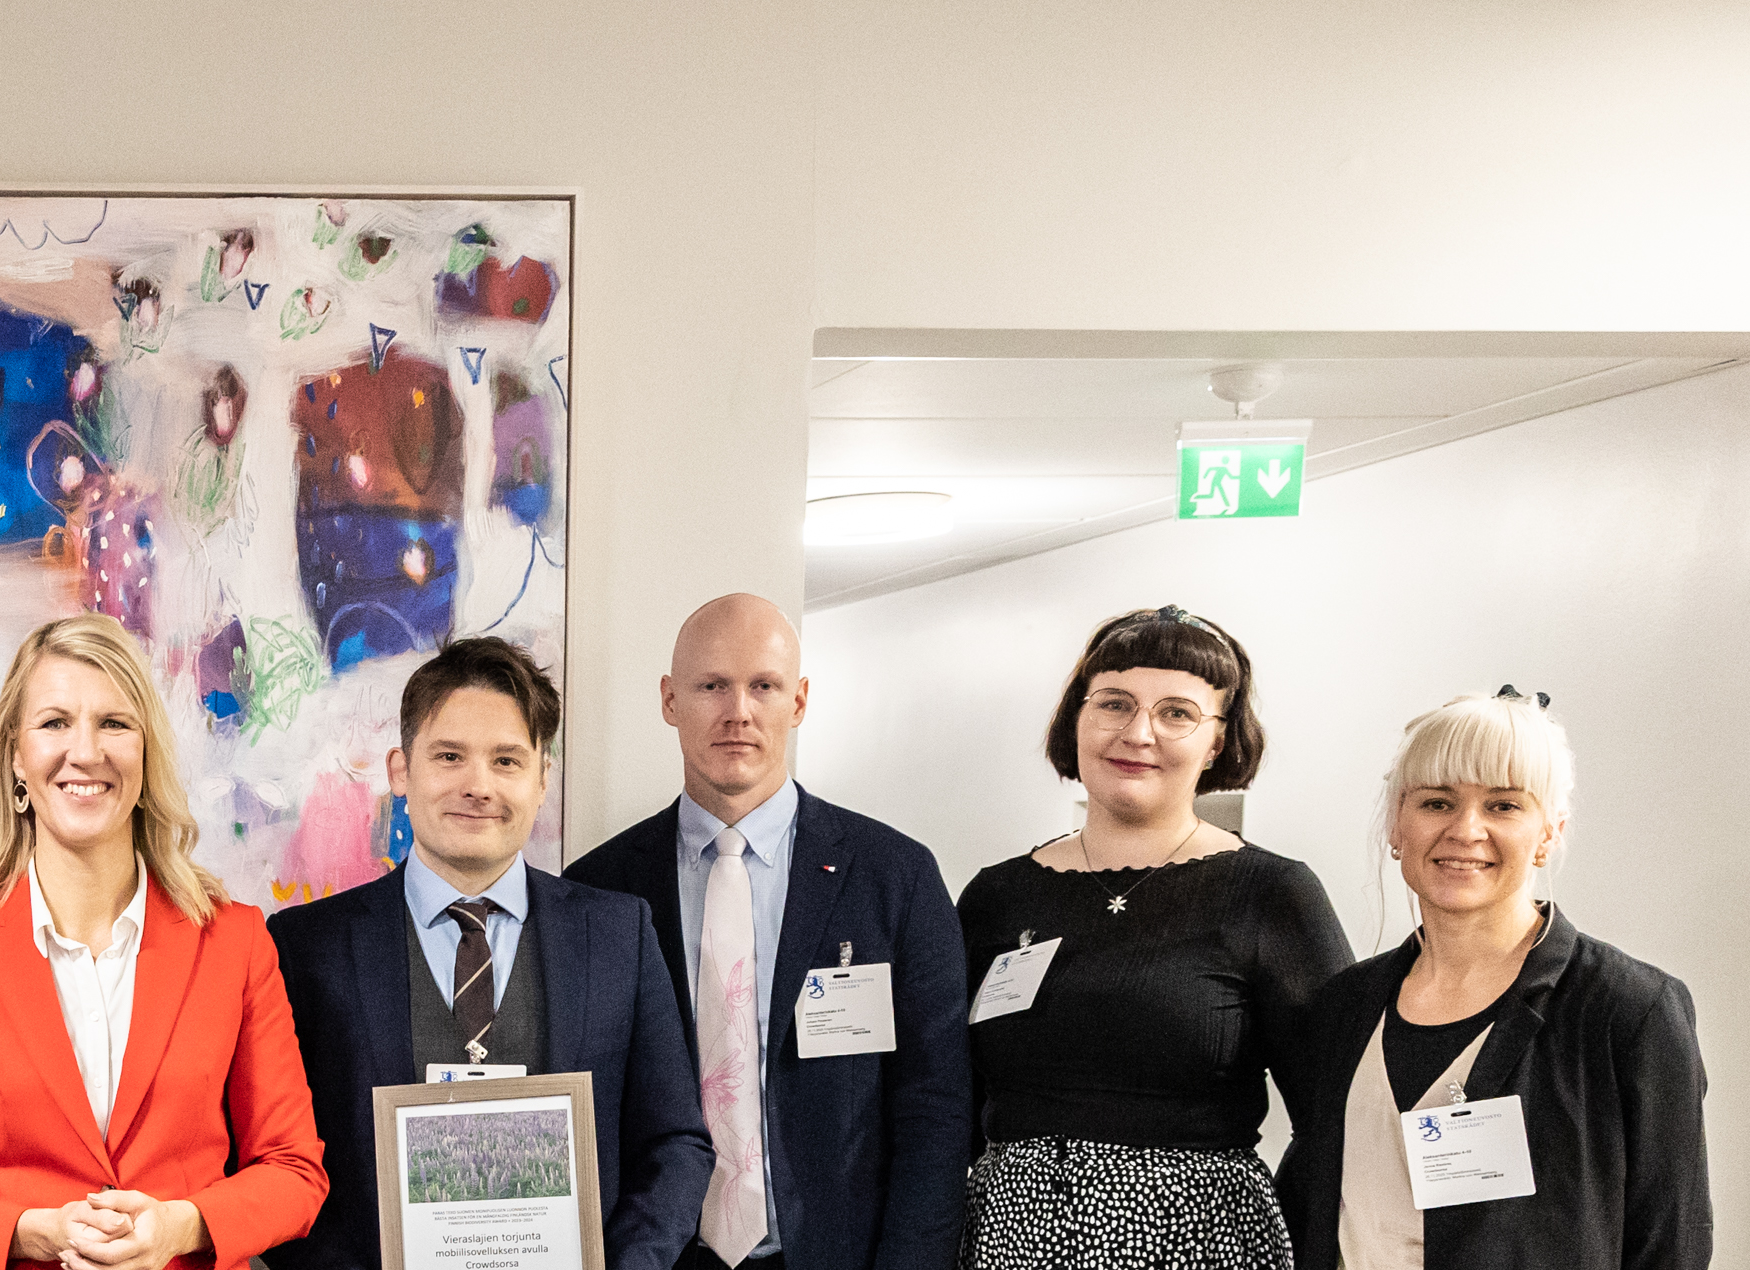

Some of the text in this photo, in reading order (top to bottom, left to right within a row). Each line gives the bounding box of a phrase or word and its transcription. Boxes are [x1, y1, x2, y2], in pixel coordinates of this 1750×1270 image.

[442, 1232, 541, 1245] Vieraslajien torjunta
[435, 1244, 549, 1257] mobiilisovelluksen avulla
[465, 1260, 519, 1270] Crowdsorsa
